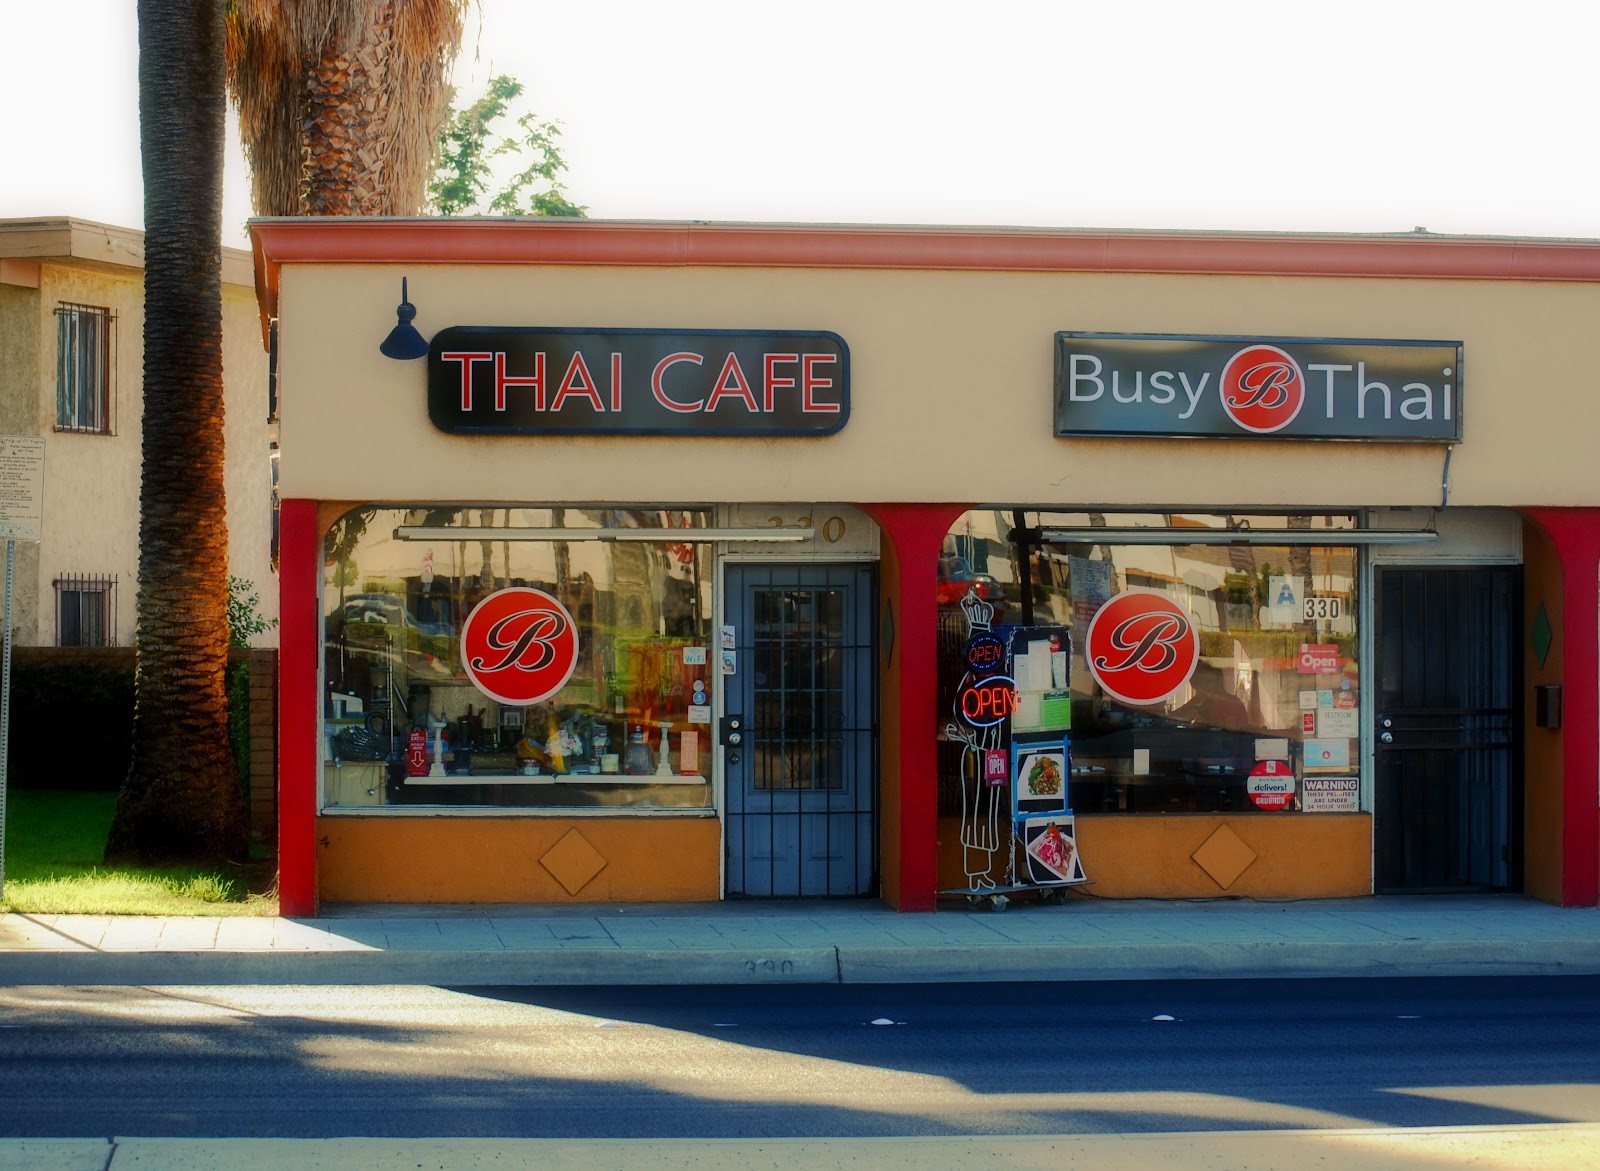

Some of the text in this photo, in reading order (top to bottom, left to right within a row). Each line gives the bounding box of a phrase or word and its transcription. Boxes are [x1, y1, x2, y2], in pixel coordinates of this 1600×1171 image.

[441, 351, 841, 414] THAI CAFE
[1069, 353, 1211, 419] Busy
[1308, 362, 1453, 421] Thai
[1277, 584, 1296, 605] A
[1305, 599, 1339, 618] 330
[471, 608, 567, 673] B
[1094, 611, 1189, 673] B
[968, 645, 1002, 663] OPEN
[1301, 653, 1337, 670] Open
[962, 687, 1019, 717] OPEN
[989, 758, 1005, 775] OPEN
[1254, 783, 1287, 791] delivers!
[1305, 780, 1357, 790] WARNING
